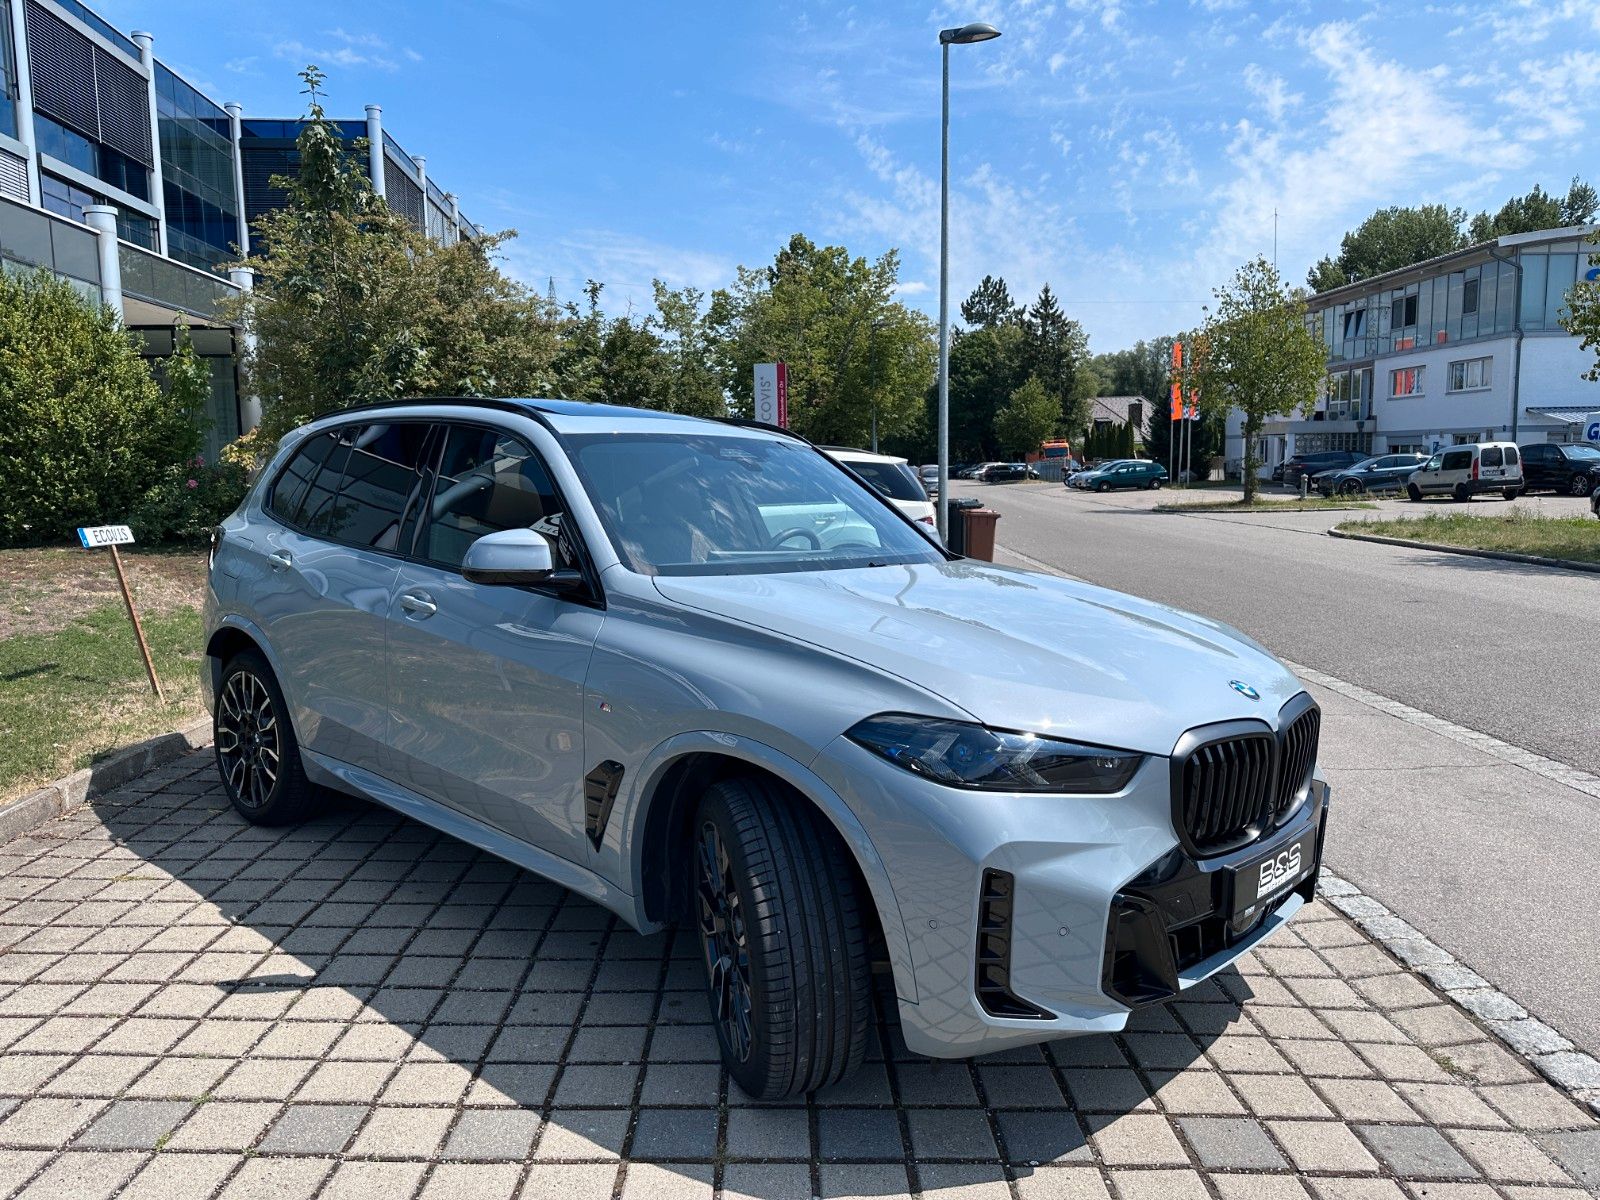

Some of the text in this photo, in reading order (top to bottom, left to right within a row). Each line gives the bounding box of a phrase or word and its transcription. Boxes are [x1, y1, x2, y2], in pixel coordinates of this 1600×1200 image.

[760, 380, 772, 422] COVIS
[1587, 422, 1600, 441] G
[93, 527, 129, 543] ECOVIS
[1260, 842, 1302, 888] B&S
